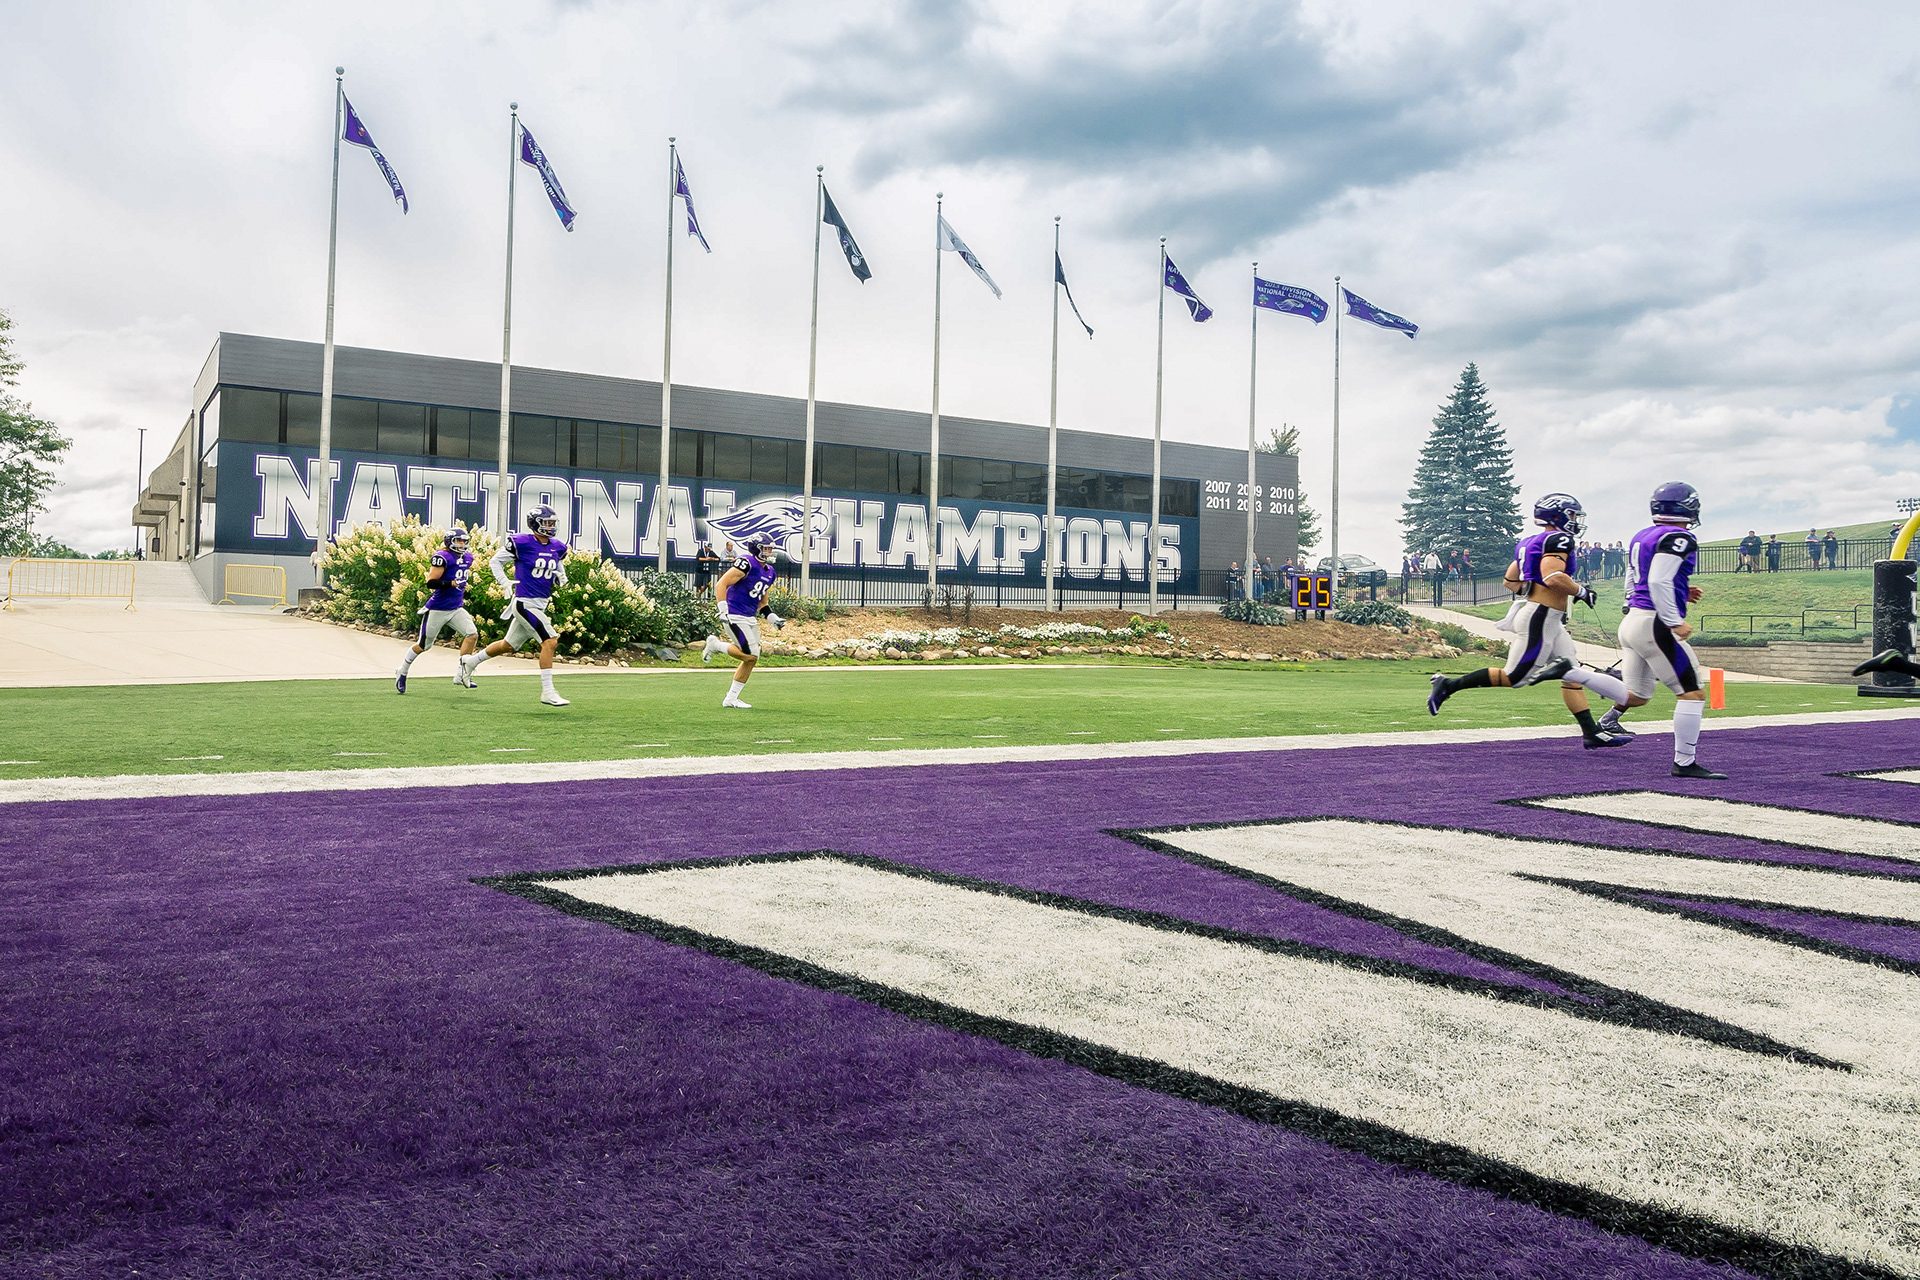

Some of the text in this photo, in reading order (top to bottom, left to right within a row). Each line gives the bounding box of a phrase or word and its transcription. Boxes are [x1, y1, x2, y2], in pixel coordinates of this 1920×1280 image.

[1257, 285, 1325, 311] NATIONAL CHAMPIONS
[1281, 286, 1312, 298] DIVISION
[1205, 480, 1294, 500] 2007 209 2010
[1206, 496, 1294, 515] 2011 203 2014
[1557, 536, 1569, 549] 2
[1671, 537, 1688, 553] 9
[431, 557, 443, 566] 80
[531, 557, 556, 580] 88
[734, 558, 748, 570] 85
[1297, 577, 1330, 607] 25
